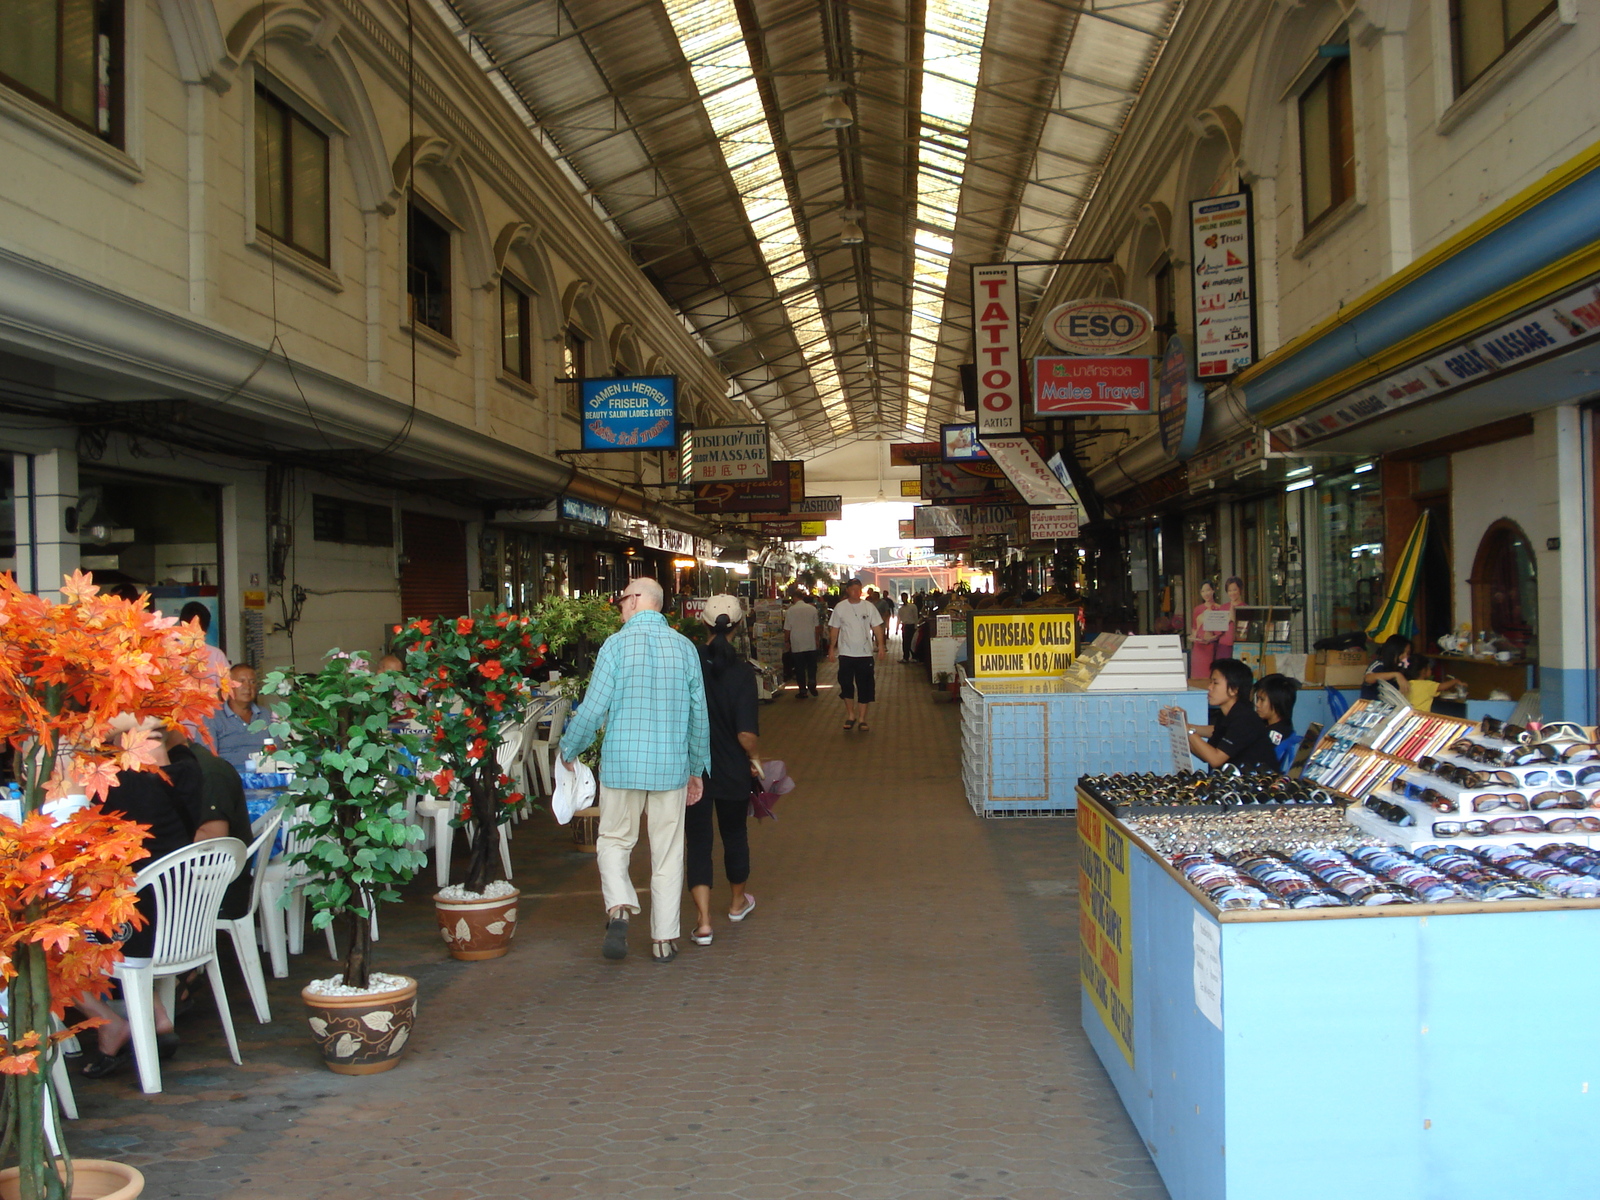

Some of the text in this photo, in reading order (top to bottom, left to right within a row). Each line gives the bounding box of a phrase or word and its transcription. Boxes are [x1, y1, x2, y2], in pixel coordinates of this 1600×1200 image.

[1220, 233, 1244, 245] Thai
[1228, 289, 1249, 303] JAL
[1069, 314, 1134, 337] ESO
[1224, 331, 1249, 341] KLM
[979, 279, 1014, 413] TATTOO
[1444, 322, 1558, 379] GREAT MASSAGE
[1233, 357, 1250, 365] SAS
[589, 383, 622, 409] DAMEN
[632, 382, 669, 407] HERREN
[1041, 381, 1145, 400] Malee Travel
[608, 398, 649, 409] FRISEUR
[585, 410, 608, 420] BEAUTY
[608, 410, 628, 419] SALON
[629, 409, 648, 418] LADIES
[654, 408, 673, 417] GENTS
[983, 417, 1013, 428] ARTIST
[709, 448, 766, 462] MASSAGE
[1020, 449, 1066, 500] PIERCING
[799, 499, 841, 513] FASHION
[1031, 522, 1077, 530] TATTOO
[1031, 530, 1077, 538] REMOVE
[977, 620, 1072, 647] OVERSEAS CALLS
[980, 653, 1024, 672] LANDLINE
